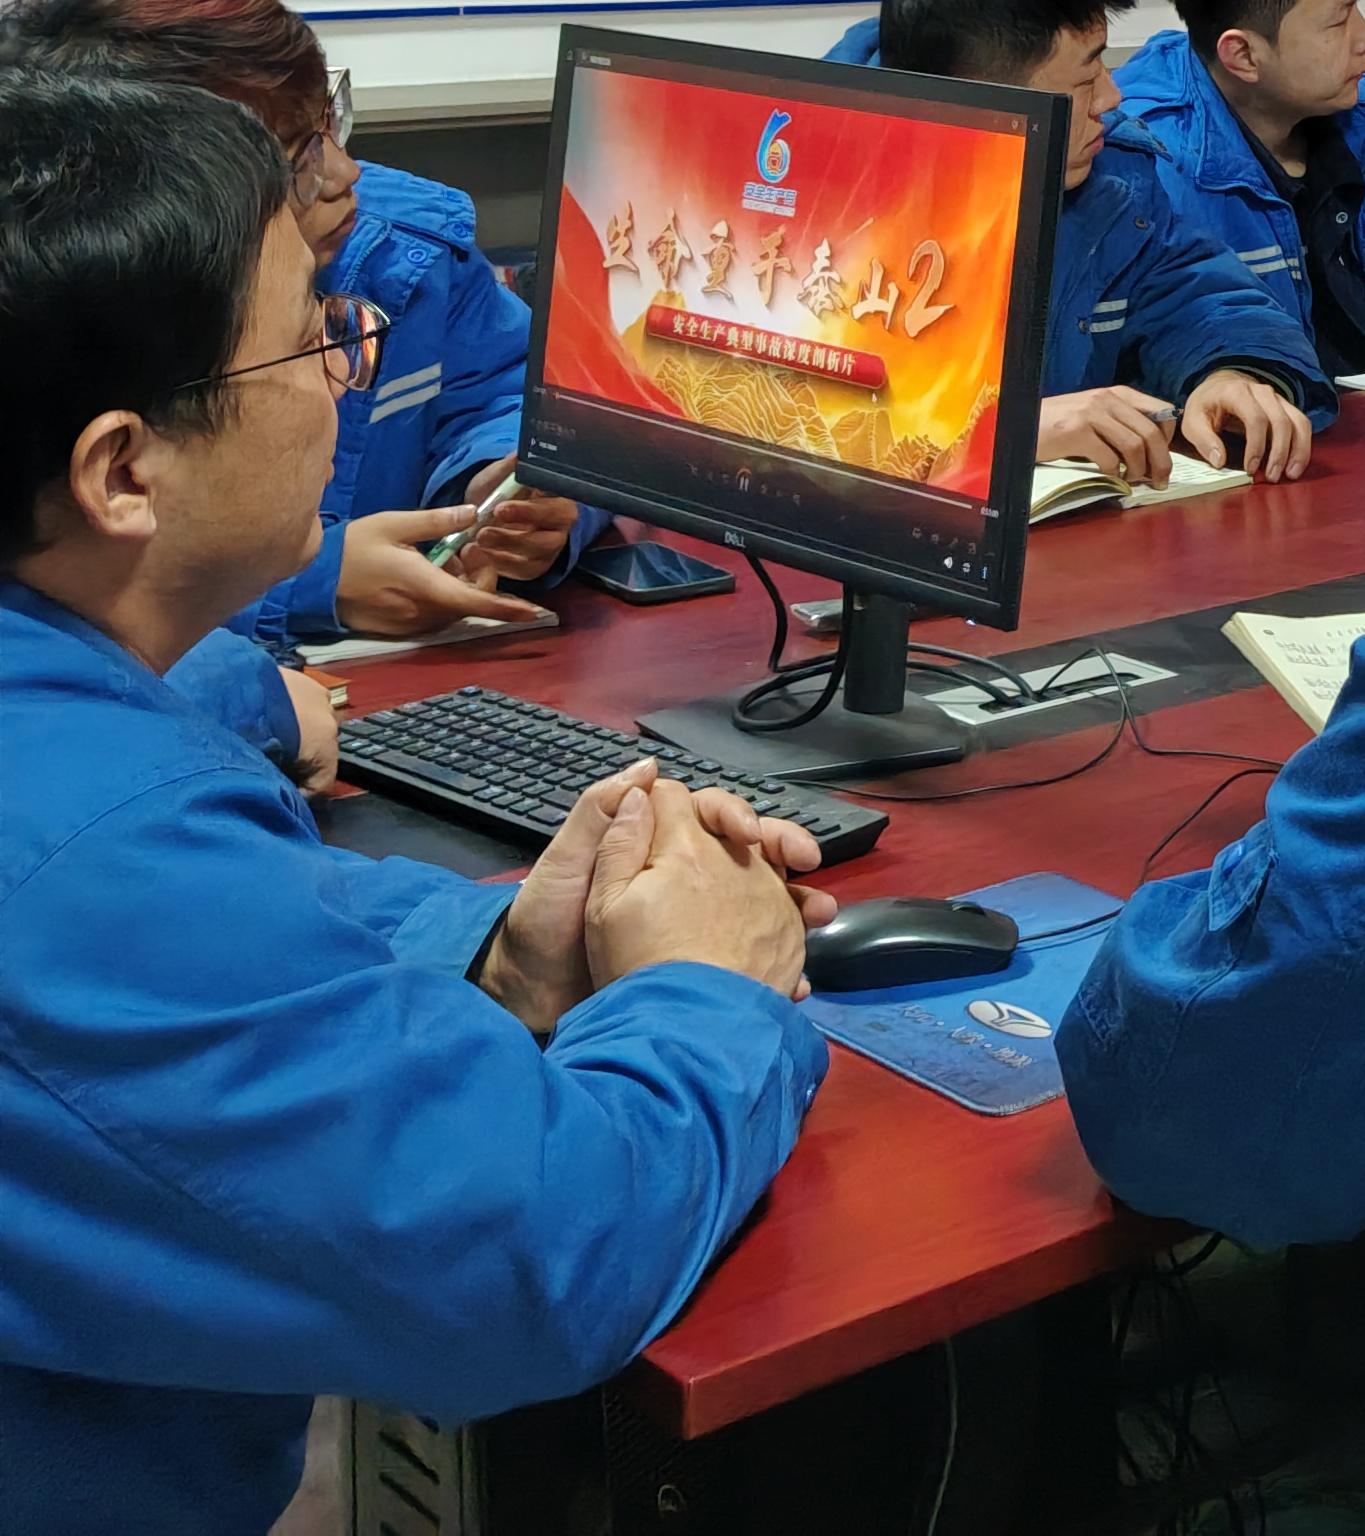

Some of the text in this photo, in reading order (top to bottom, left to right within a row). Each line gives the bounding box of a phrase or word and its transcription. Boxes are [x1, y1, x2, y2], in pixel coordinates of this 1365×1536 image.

[672, 313, 857, 377] 安全生产典型事故深度剖析片
